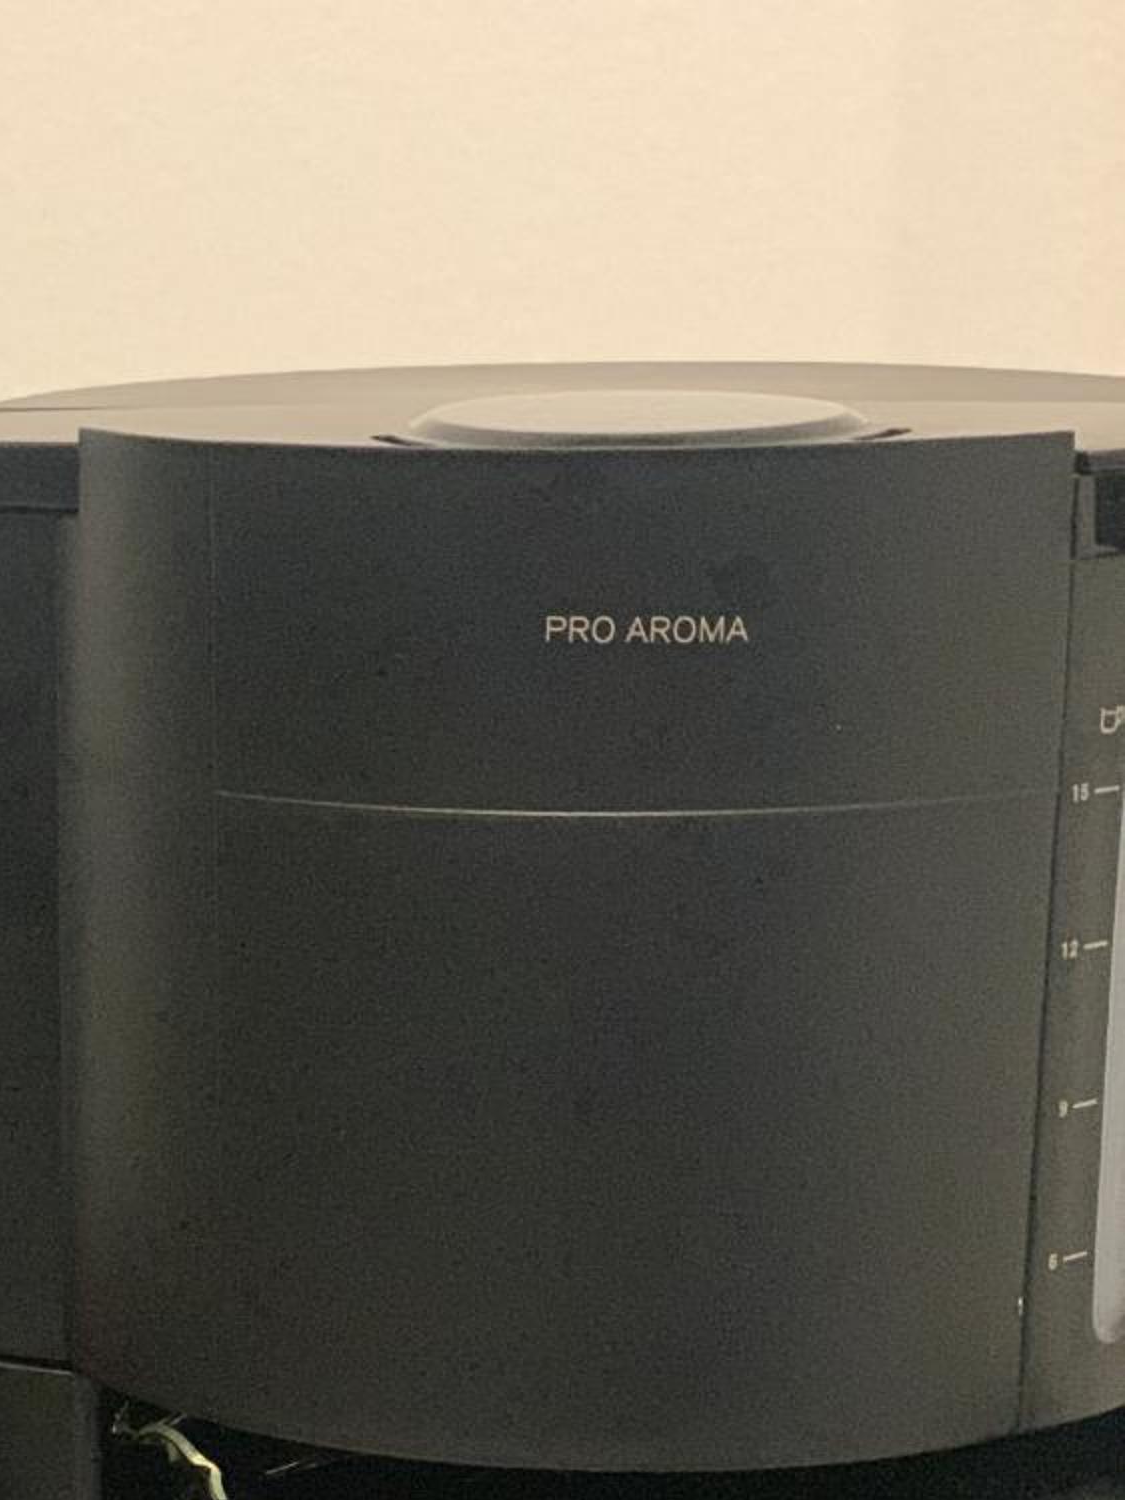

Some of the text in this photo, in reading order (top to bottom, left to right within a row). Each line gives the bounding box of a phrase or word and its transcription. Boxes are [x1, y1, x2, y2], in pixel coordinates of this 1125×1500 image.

[545, 615, 749, 644] PRO AROMA
[1072, 782, 1090, 803] 15
[1061, 939, 1078, 960] 12
[1058, 1100, 1069, 1119] 9
